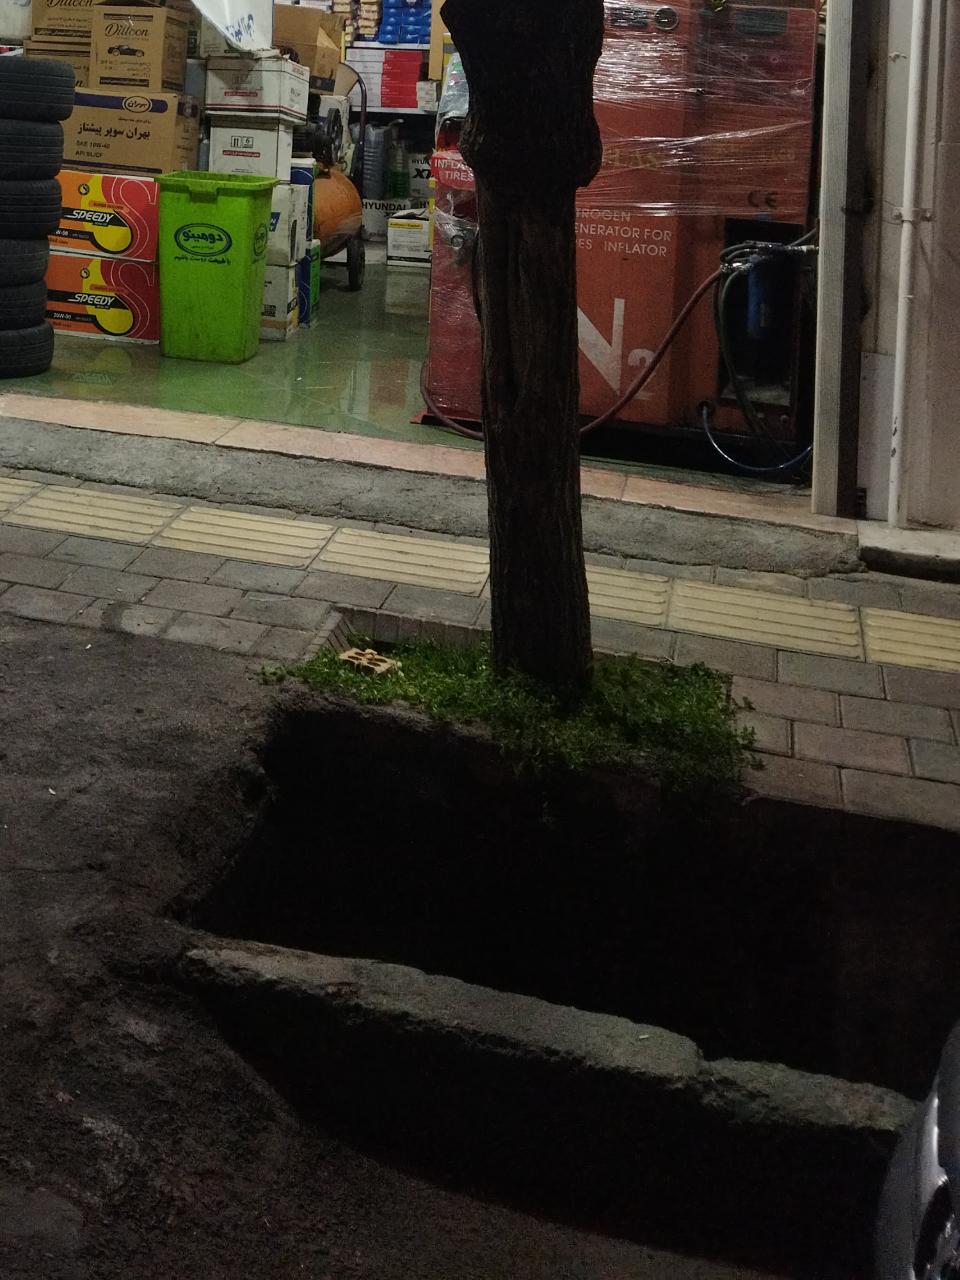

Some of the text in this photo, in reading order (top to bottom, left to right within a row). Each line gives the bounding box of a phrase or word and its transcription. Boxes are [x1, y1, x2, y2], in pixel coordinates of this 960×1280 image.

[77, 121, 151, 141] بهران سوپر پیشتاز
[361, 201, 407, 212] HYUNDAI
[64, 209, 115, 223] SPEEDY
[182, 230, 225, 245] دومینو
[644, 228, 672, 243] FOR
[604, 240, 668, 257] INFLATOR
[67, 293, 116, 306] SPEEDY
